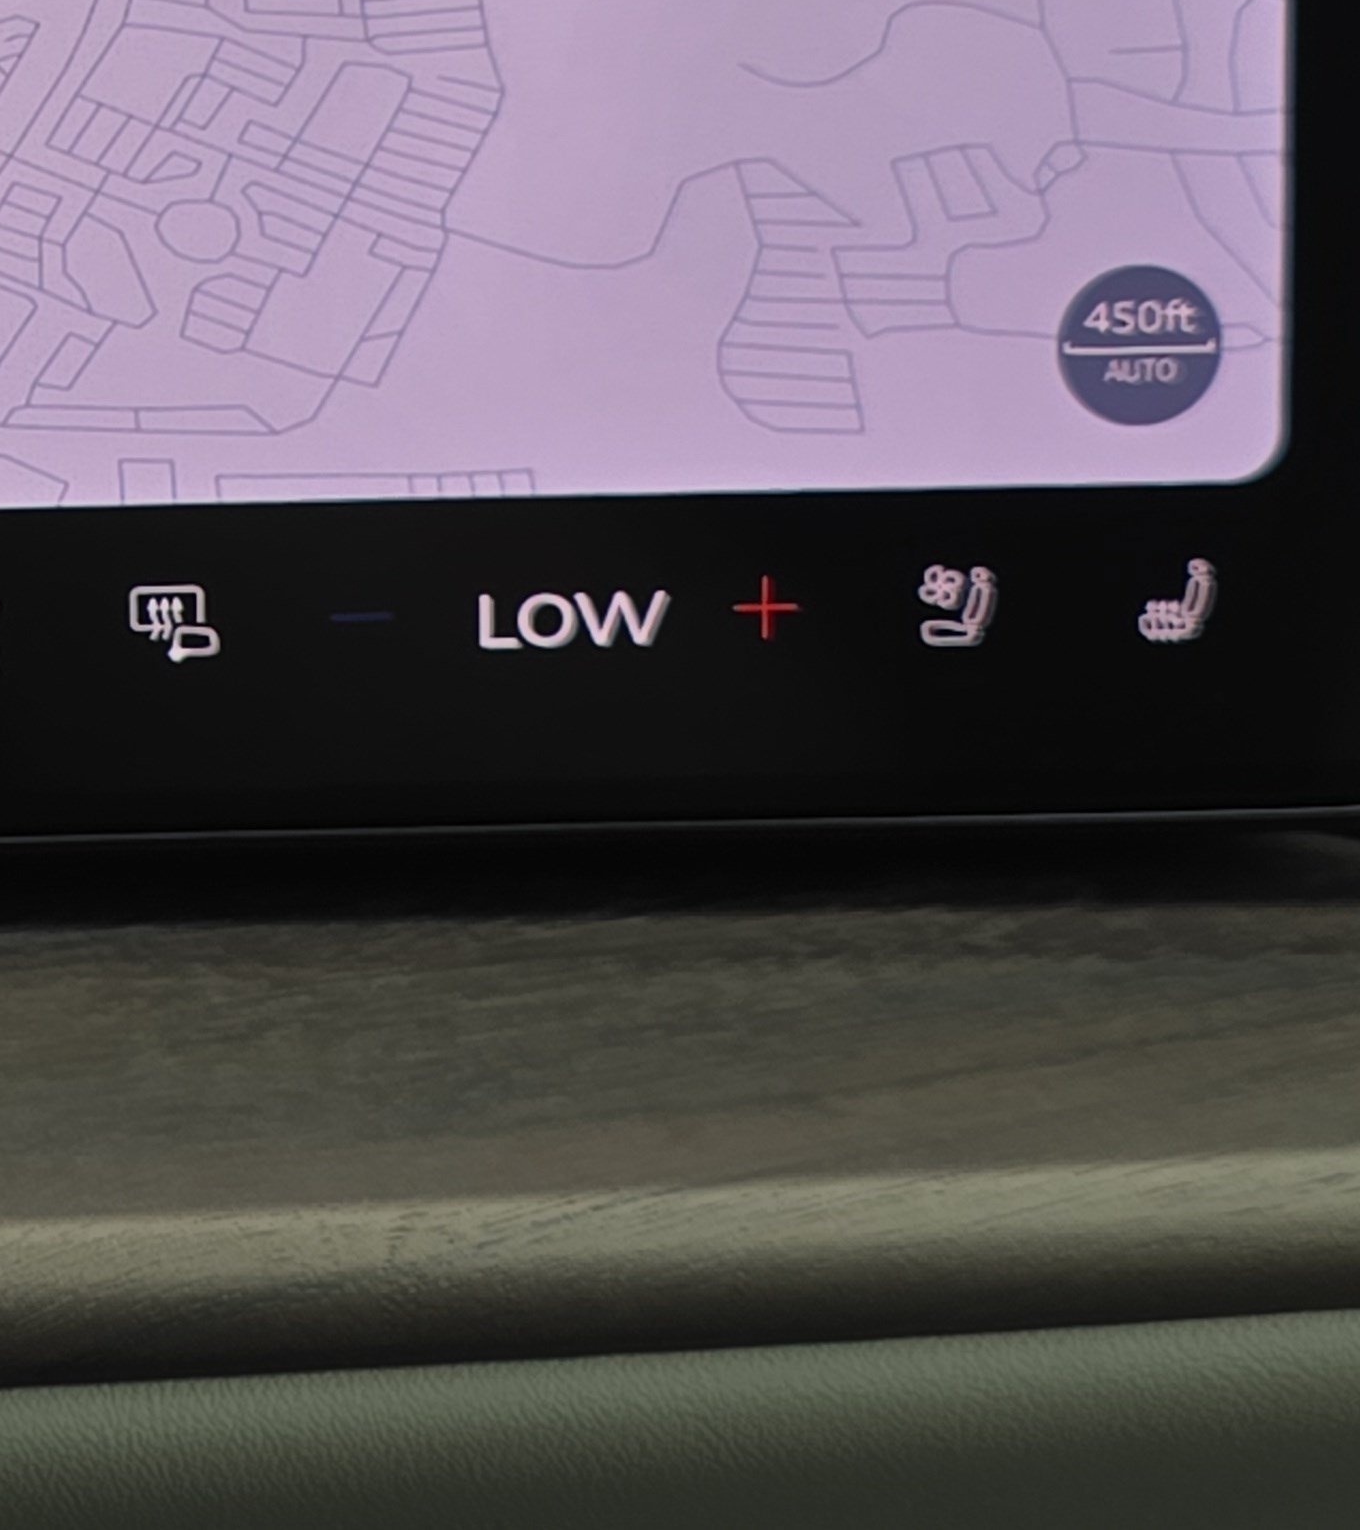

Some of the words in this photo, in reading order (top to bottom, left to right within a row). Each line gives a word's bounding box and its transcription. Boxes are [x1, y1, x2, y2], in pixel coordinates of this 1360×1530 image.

[1081, 298, 1198, 335] 450ft
[1102, 356, 1180, 384] AUTO
[477, 589, 671, 650] LOW
